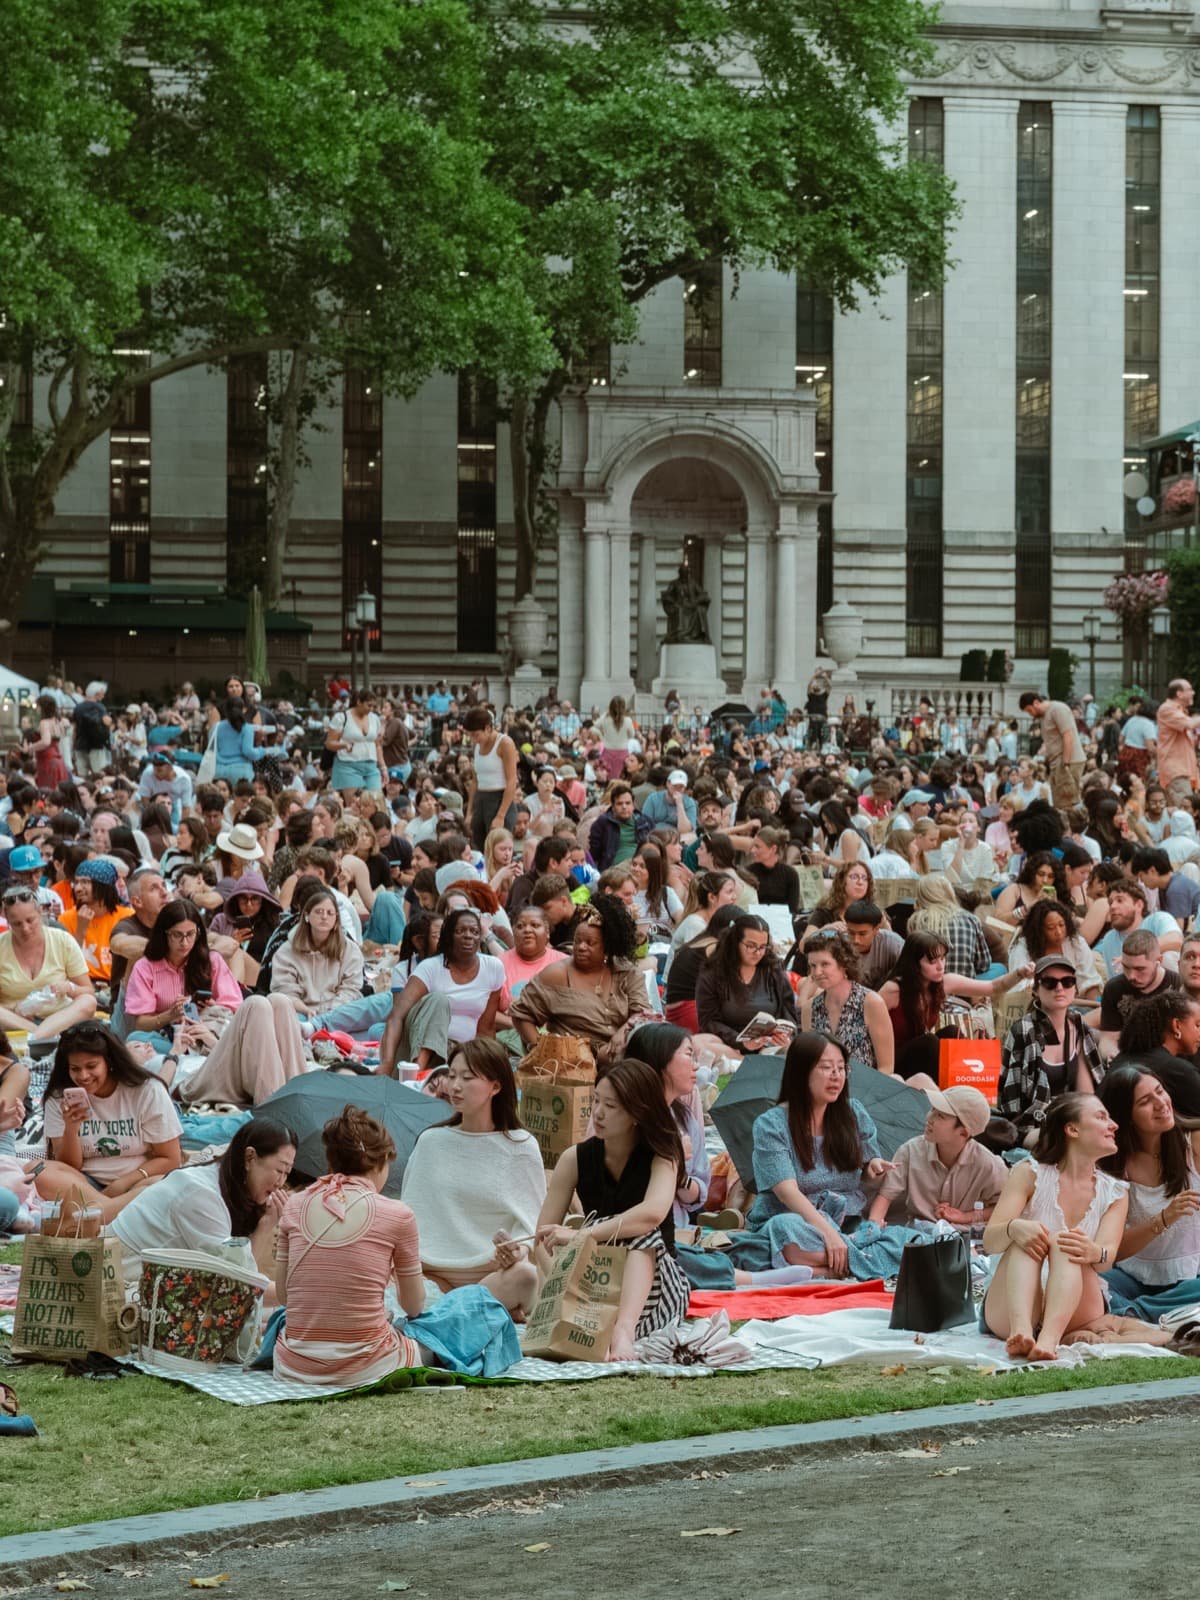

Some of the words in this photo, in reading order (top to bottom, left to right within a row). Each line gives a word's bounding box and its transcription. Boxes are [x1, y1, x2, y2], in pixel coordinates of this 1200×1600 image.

[955, 1075, 995, 1083] DOORDASH
[526, 1095, 542, 1112] IT'S
[78, 1119, 101, 1137] EW
[104, 1118, 137, 1136] YORK
[525, 1112, 559, 1133] WHAT'S
[30, 1256, 59, 1277] IT'S
[595, 1255, 613, 1267] BAN
[583, 1264, 611, 1286] 300
[28, 1280, 86, 1303] WHAT'S
[23, 1302, 57, 1325] NOT
[58, 1306, 75, 1326] IN
[21, 1326, 51, 1347] THE
[53, 1328, 88, 1350] BAG.
[567, 1330, 596, 1348] MIND
